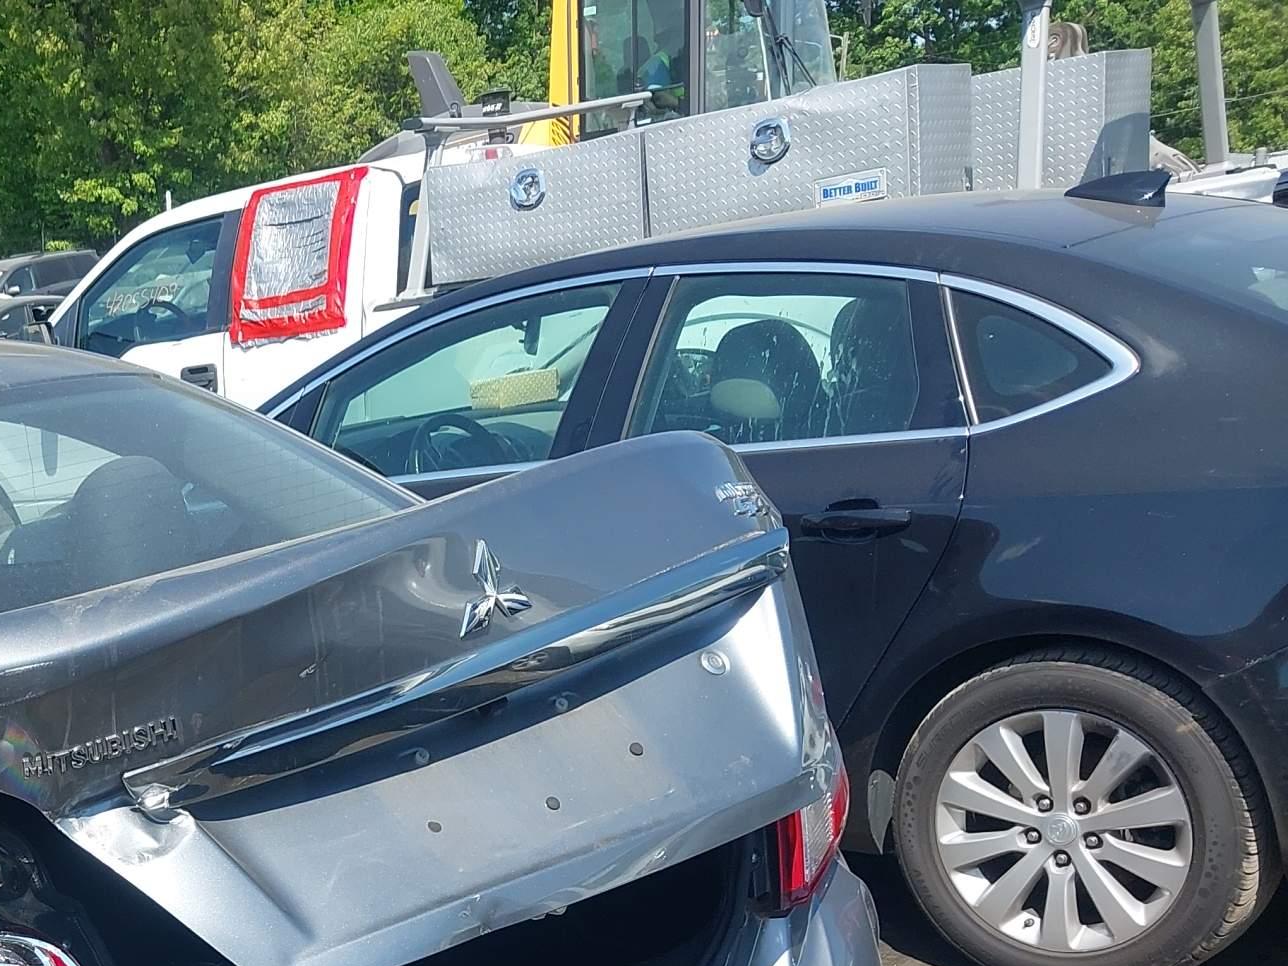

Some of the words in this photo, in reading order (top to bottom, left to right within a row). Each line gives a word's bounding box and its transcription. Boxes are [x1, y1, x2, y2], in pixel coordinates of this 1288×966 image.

[822, 184, 852, 199] BETTER
[854, 180, 879, 193] BUILT
[22, 715, 179, 780] MITSUBISHI
